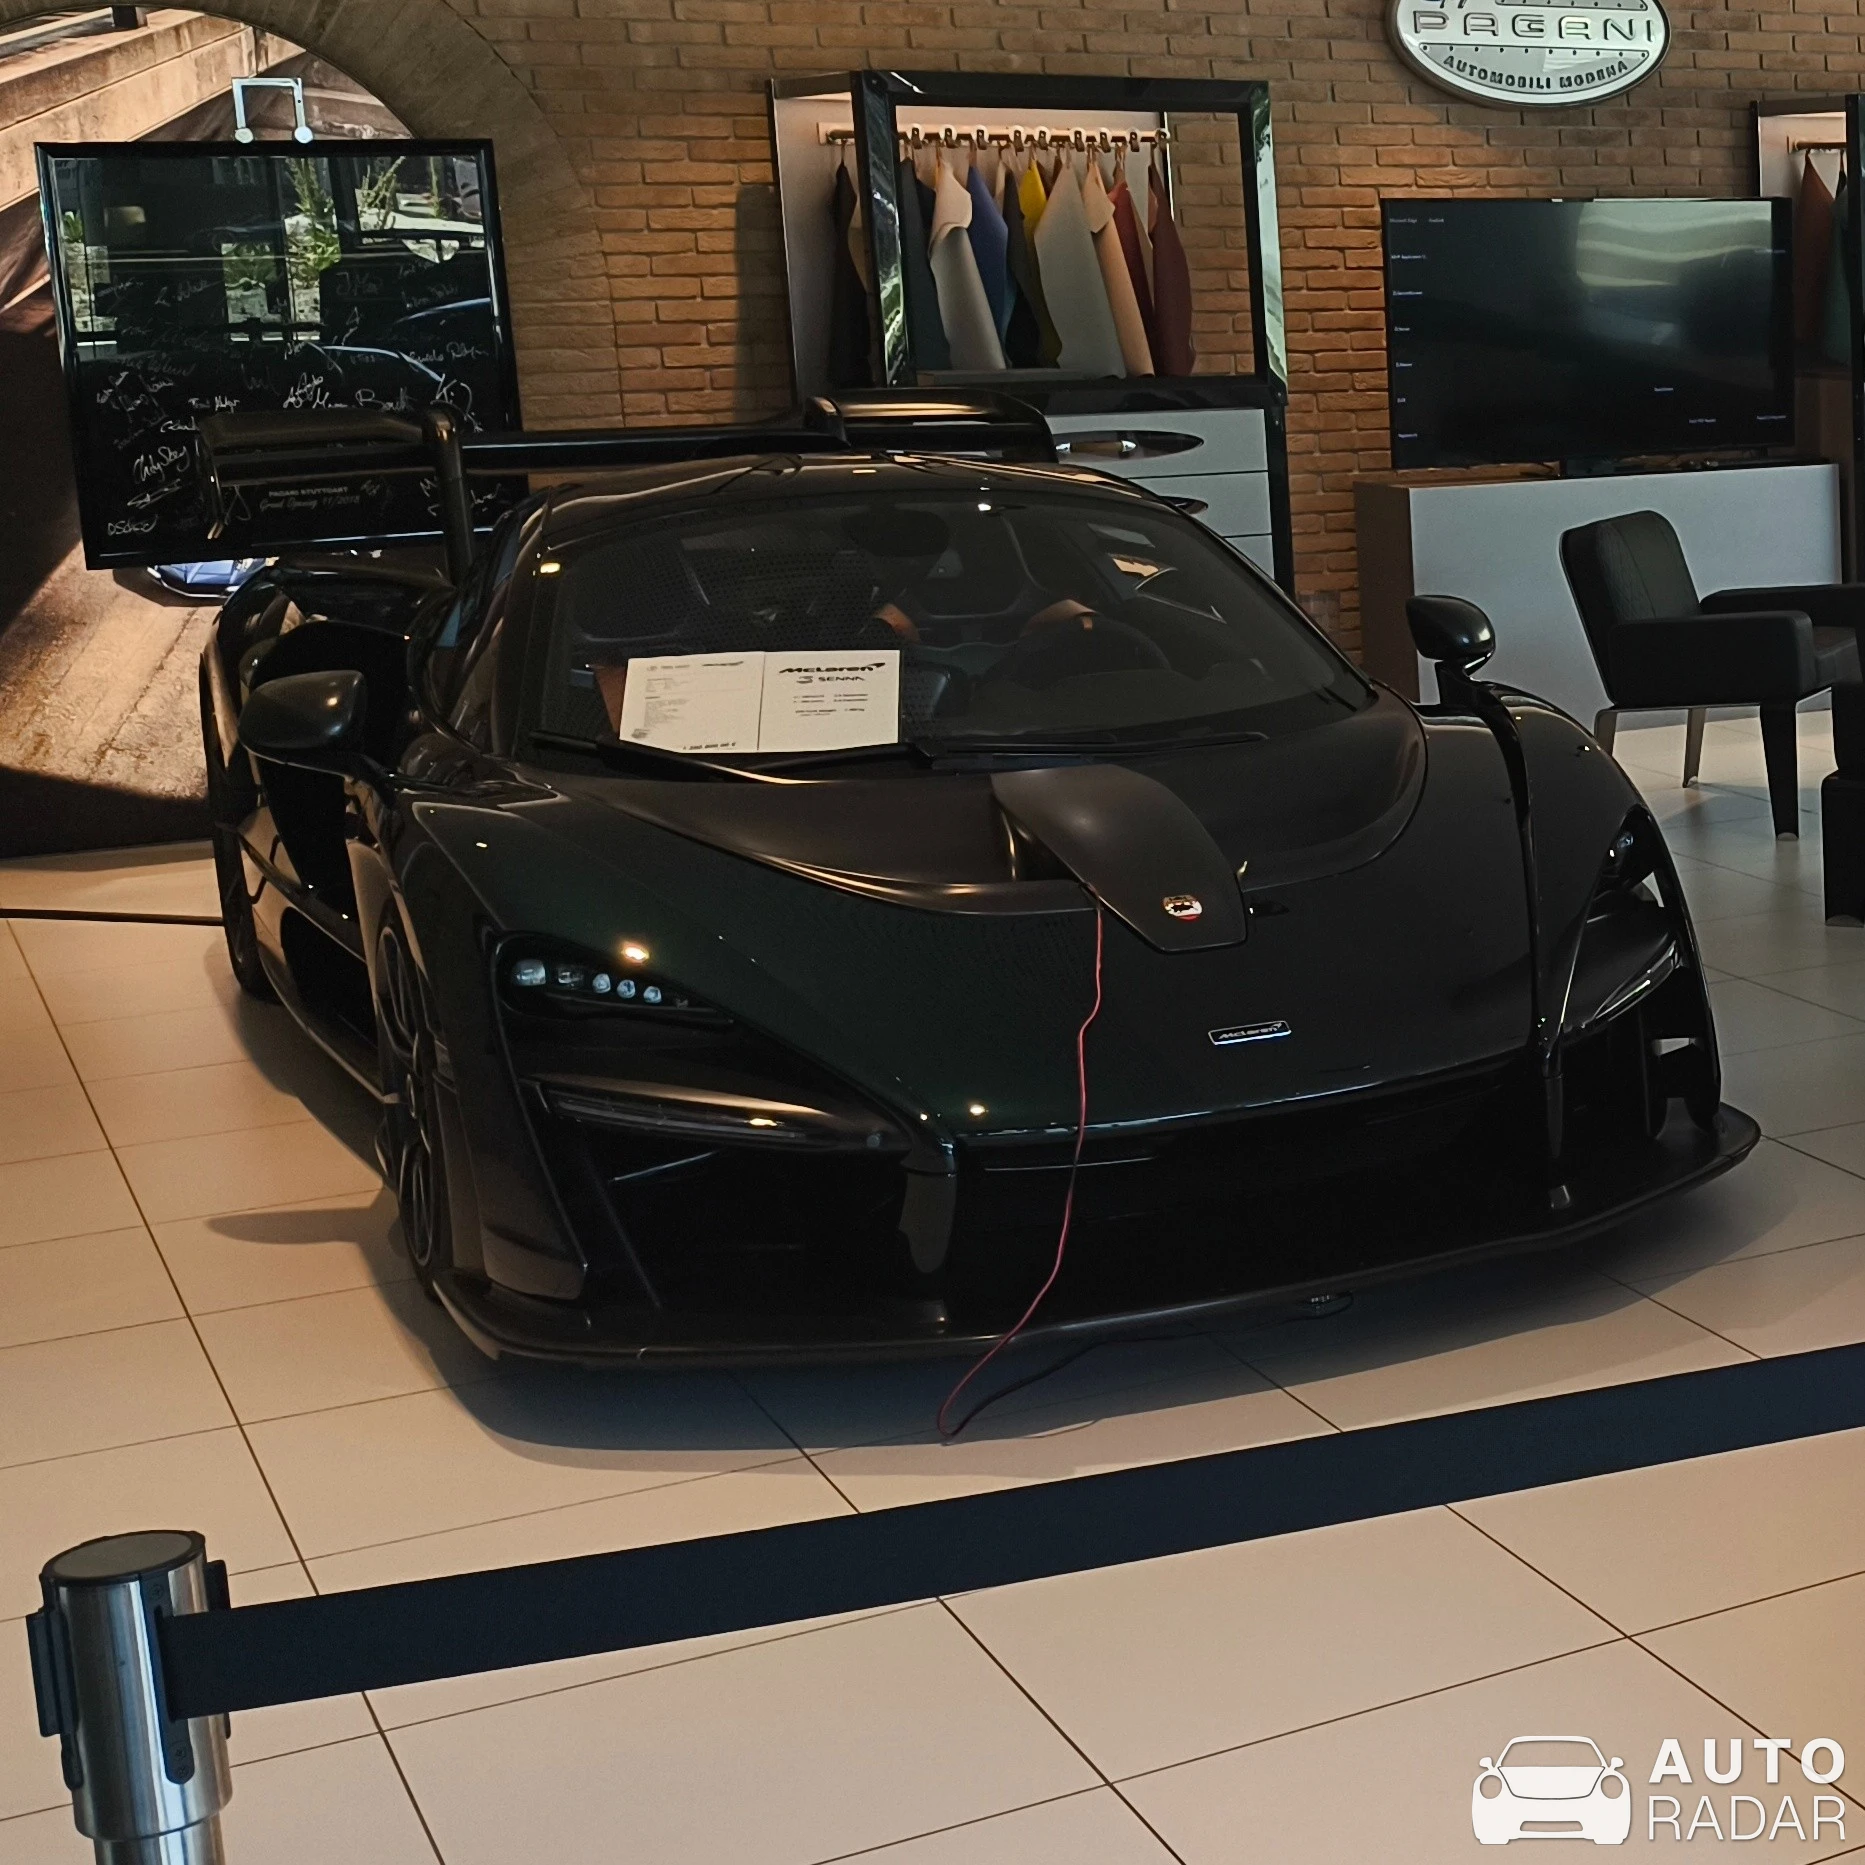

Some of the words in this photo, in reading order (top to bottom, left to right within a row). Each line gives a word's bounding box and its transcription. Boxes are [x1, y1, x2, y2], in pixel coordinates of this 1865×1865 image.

[1413, 10, 1655, 42] PAGANI
[1443, 55, 1551, 90] AUTOMOBILI
[1559, 60, 1628, 88] MODENA
[779, 663, 885, 673] McLaren
[1218, 1022, 1283, 1040] McLaren
